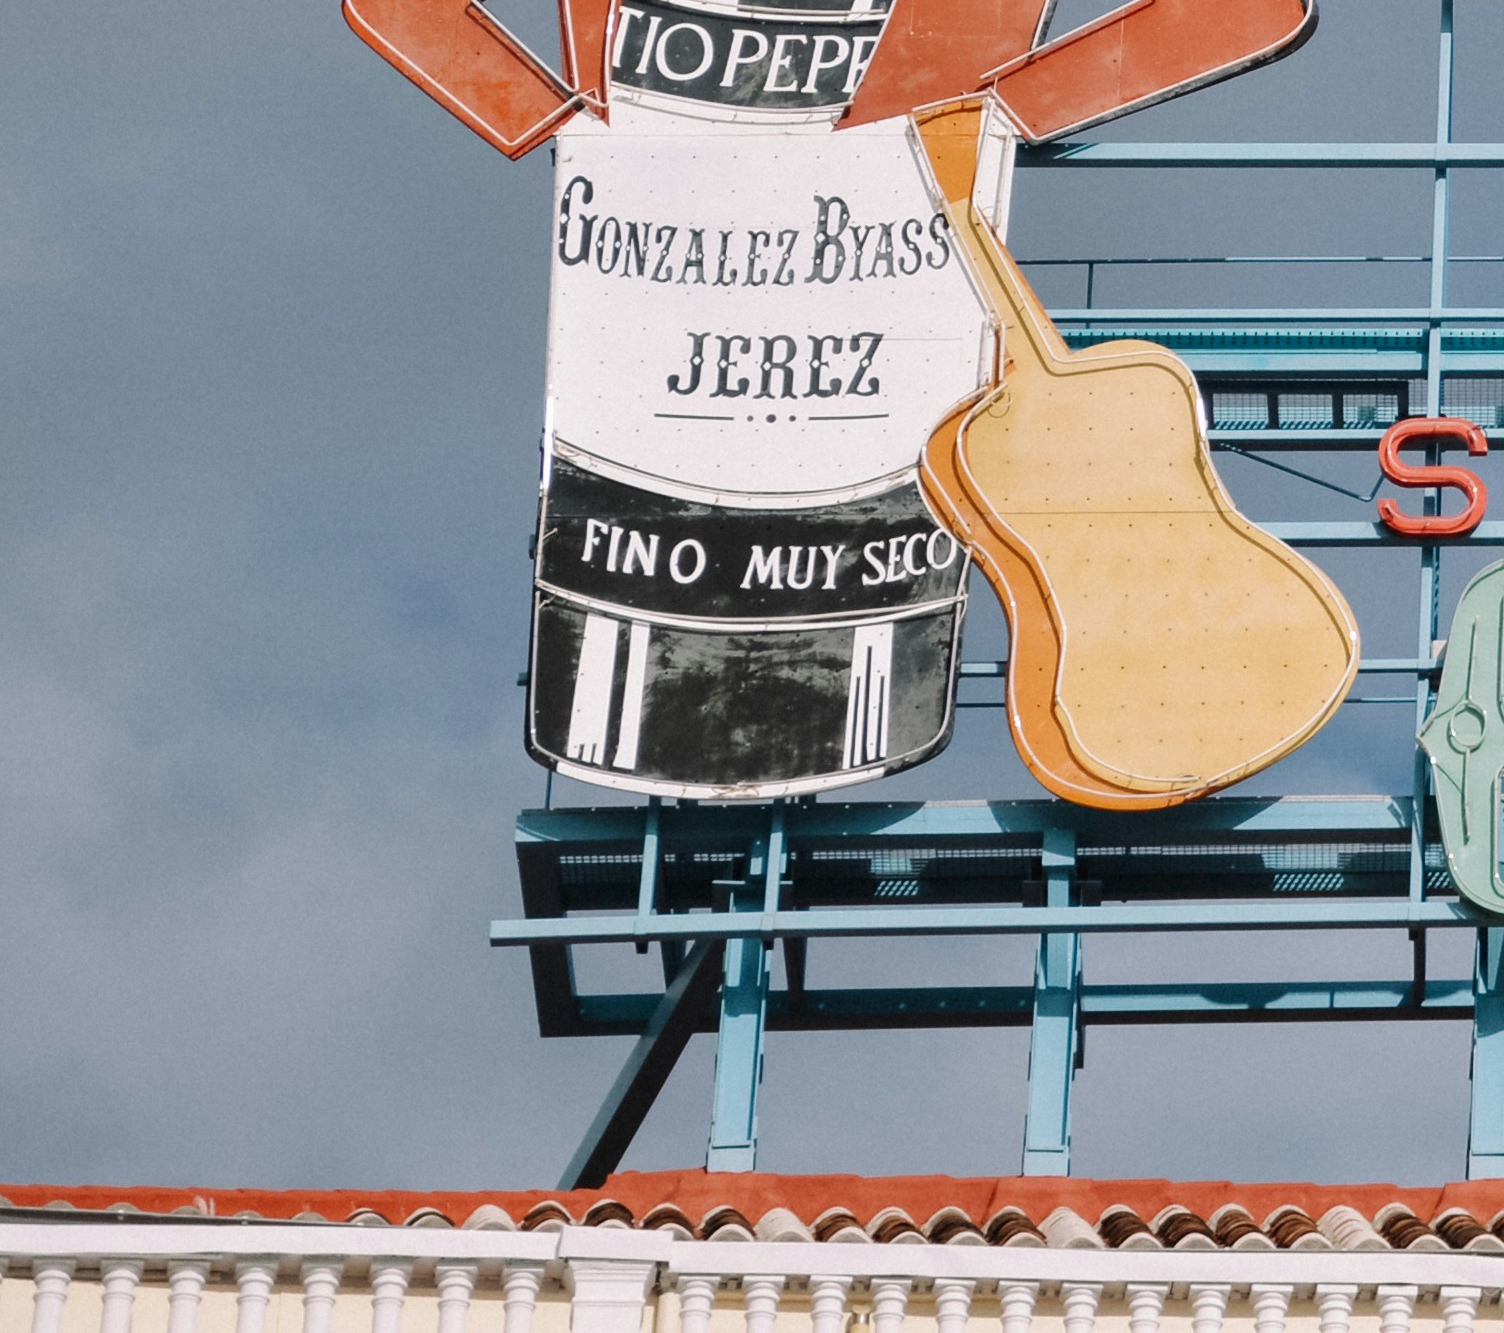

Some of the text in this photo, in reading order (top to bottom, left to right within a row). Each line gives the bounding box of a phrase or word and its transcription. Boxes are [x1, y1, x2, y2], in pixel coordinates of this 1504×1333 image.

[612, 6, 714, 81] TIO
[558, 176, 951, 286] GONZALEZ BYASS
[667, 331, 885, 400] JEREZ
[582, 518, 958, 590] FINO MUY SECO
